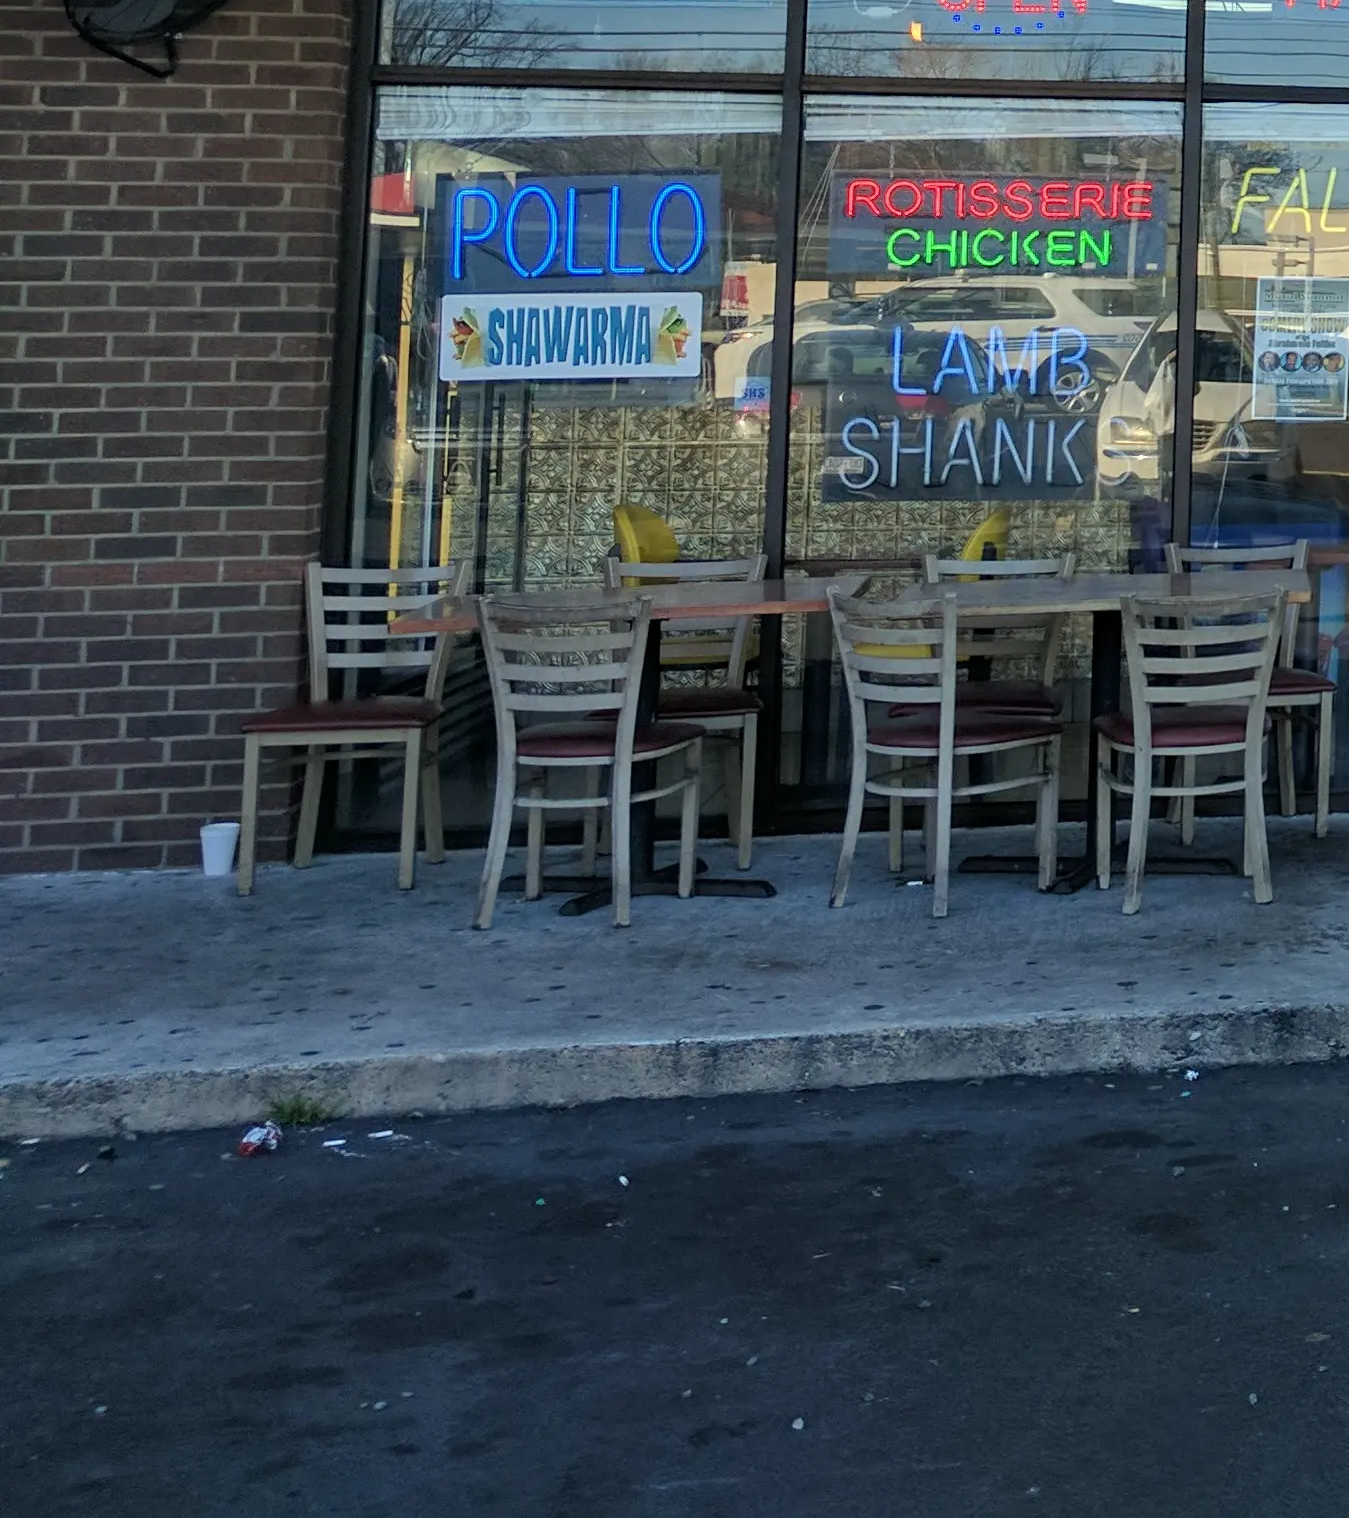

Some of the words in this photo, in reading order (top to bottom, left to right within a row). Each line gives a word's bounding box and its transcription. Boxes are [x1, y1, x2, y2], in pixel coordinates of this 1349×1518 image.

[451, 182, 707, 280] POLLO
[845, 178, 1153, 223] ROTISSERIE
[885, 228, 1113, 269] CHICKEN
[487, 304, 652, 366] SHAWARMA
[891, 325, 1093, 396] LAMB
